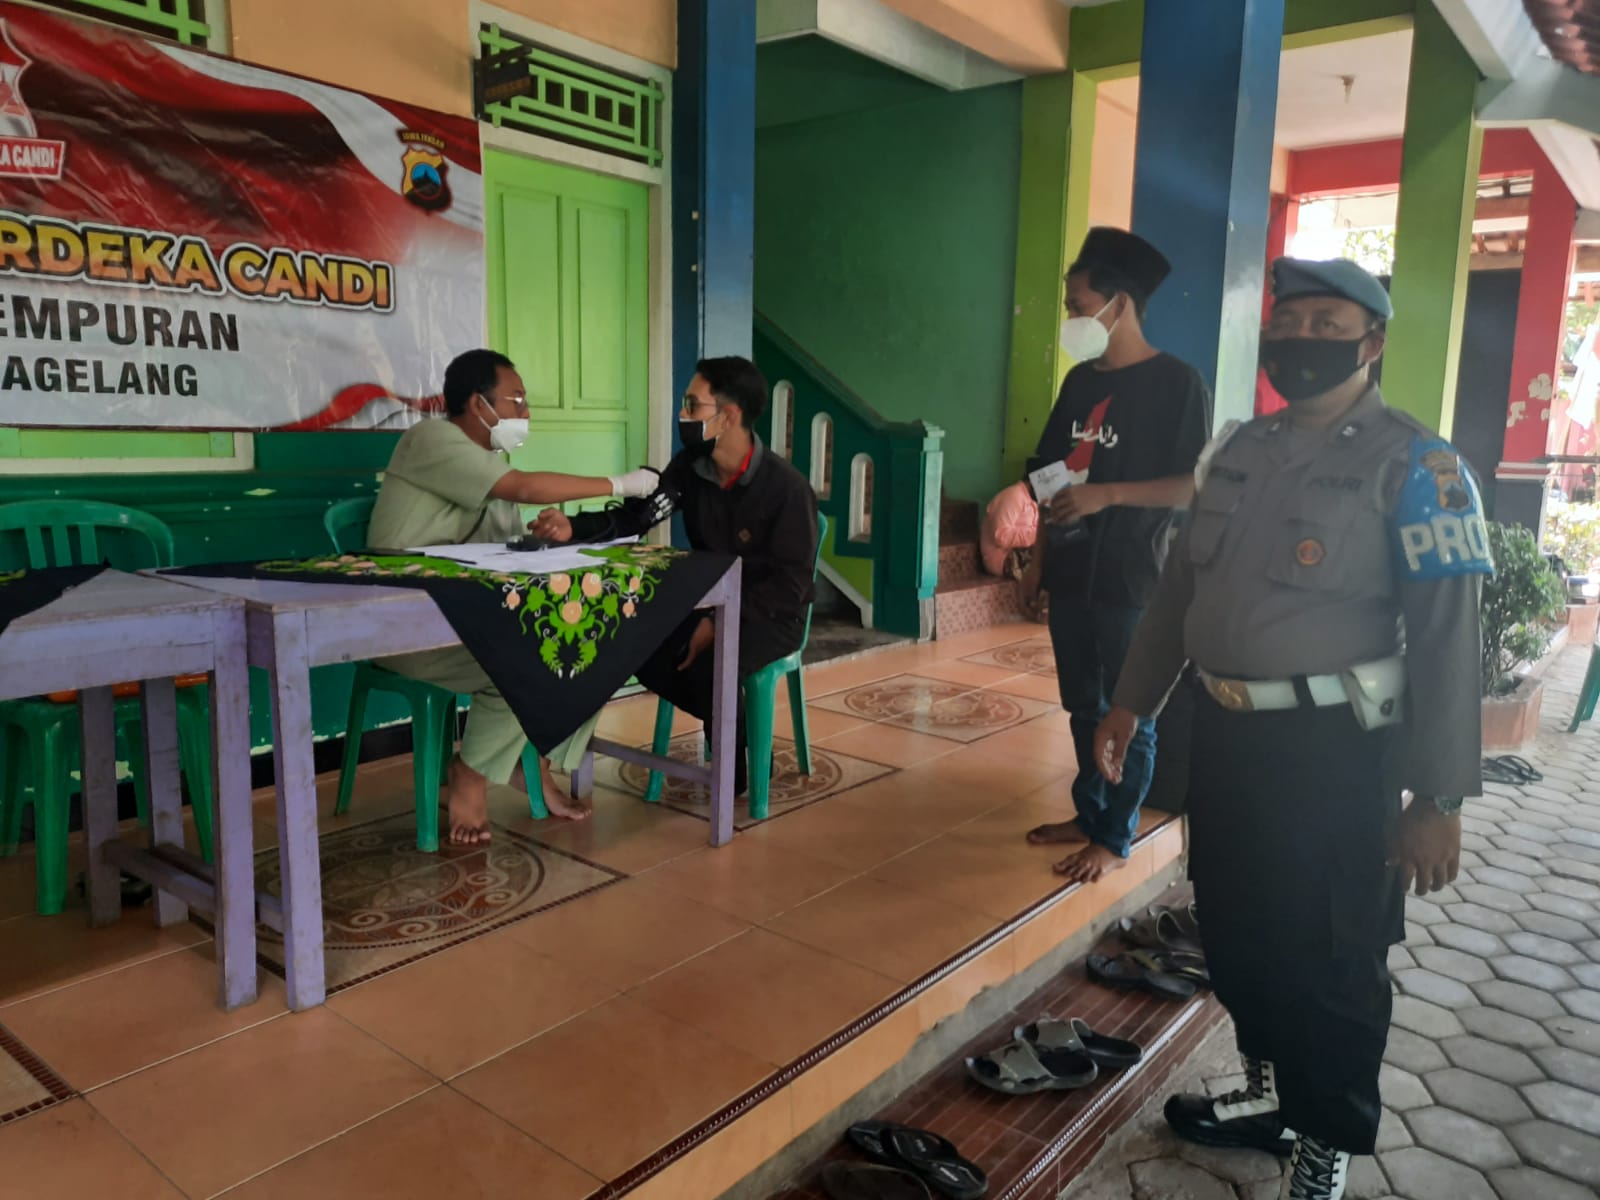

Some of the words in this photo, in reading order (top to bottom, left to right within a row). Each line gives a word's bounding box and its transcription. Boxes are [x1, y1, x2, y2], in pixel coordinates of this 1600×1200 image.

[12, 145, 55, 168] CANDI
[227, 249, 391, 310] CANDI
[2, 355, 198, 397] AGELANG
